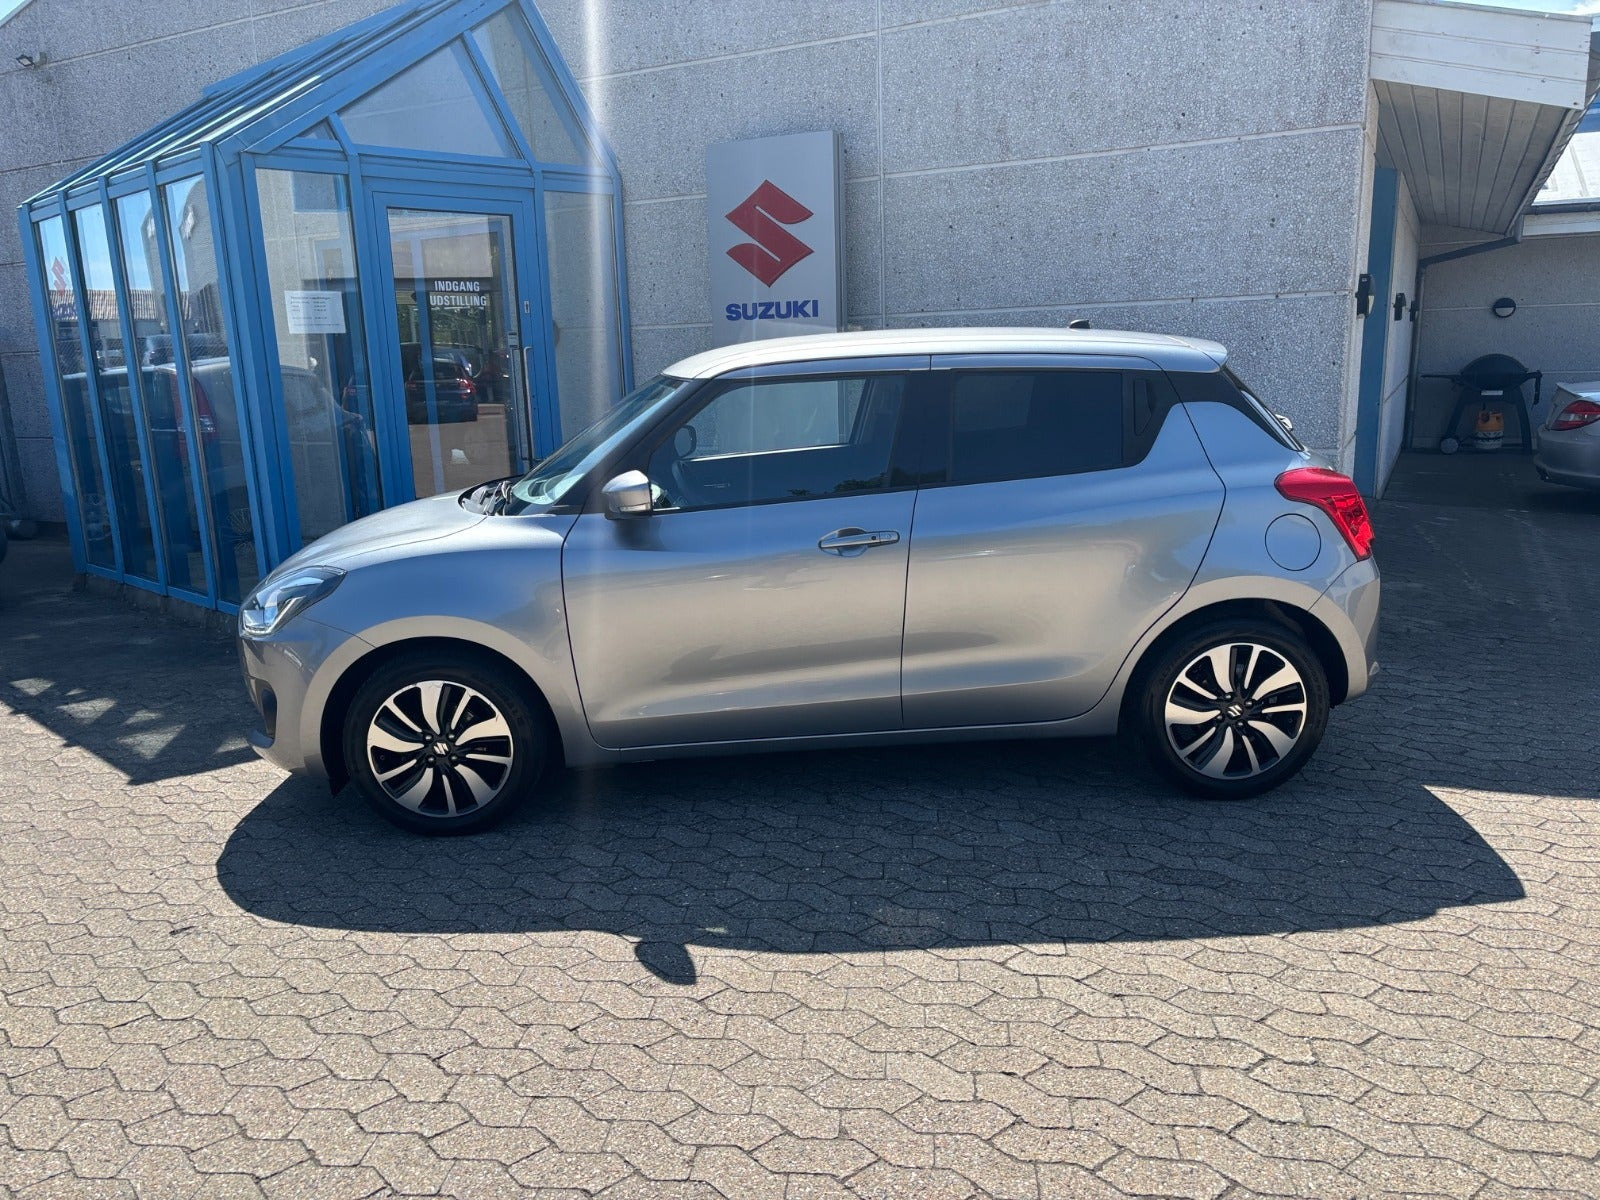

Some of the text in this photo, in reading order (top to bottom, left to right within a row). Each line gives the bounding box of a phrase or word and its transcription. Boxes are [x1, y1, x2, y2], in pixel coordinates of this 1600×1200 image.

[434, 280, 480, 292] INDGANG
[429, 295, 487, 307] UDSTILLING
[726, 299, 819, 321] SUZUKI
